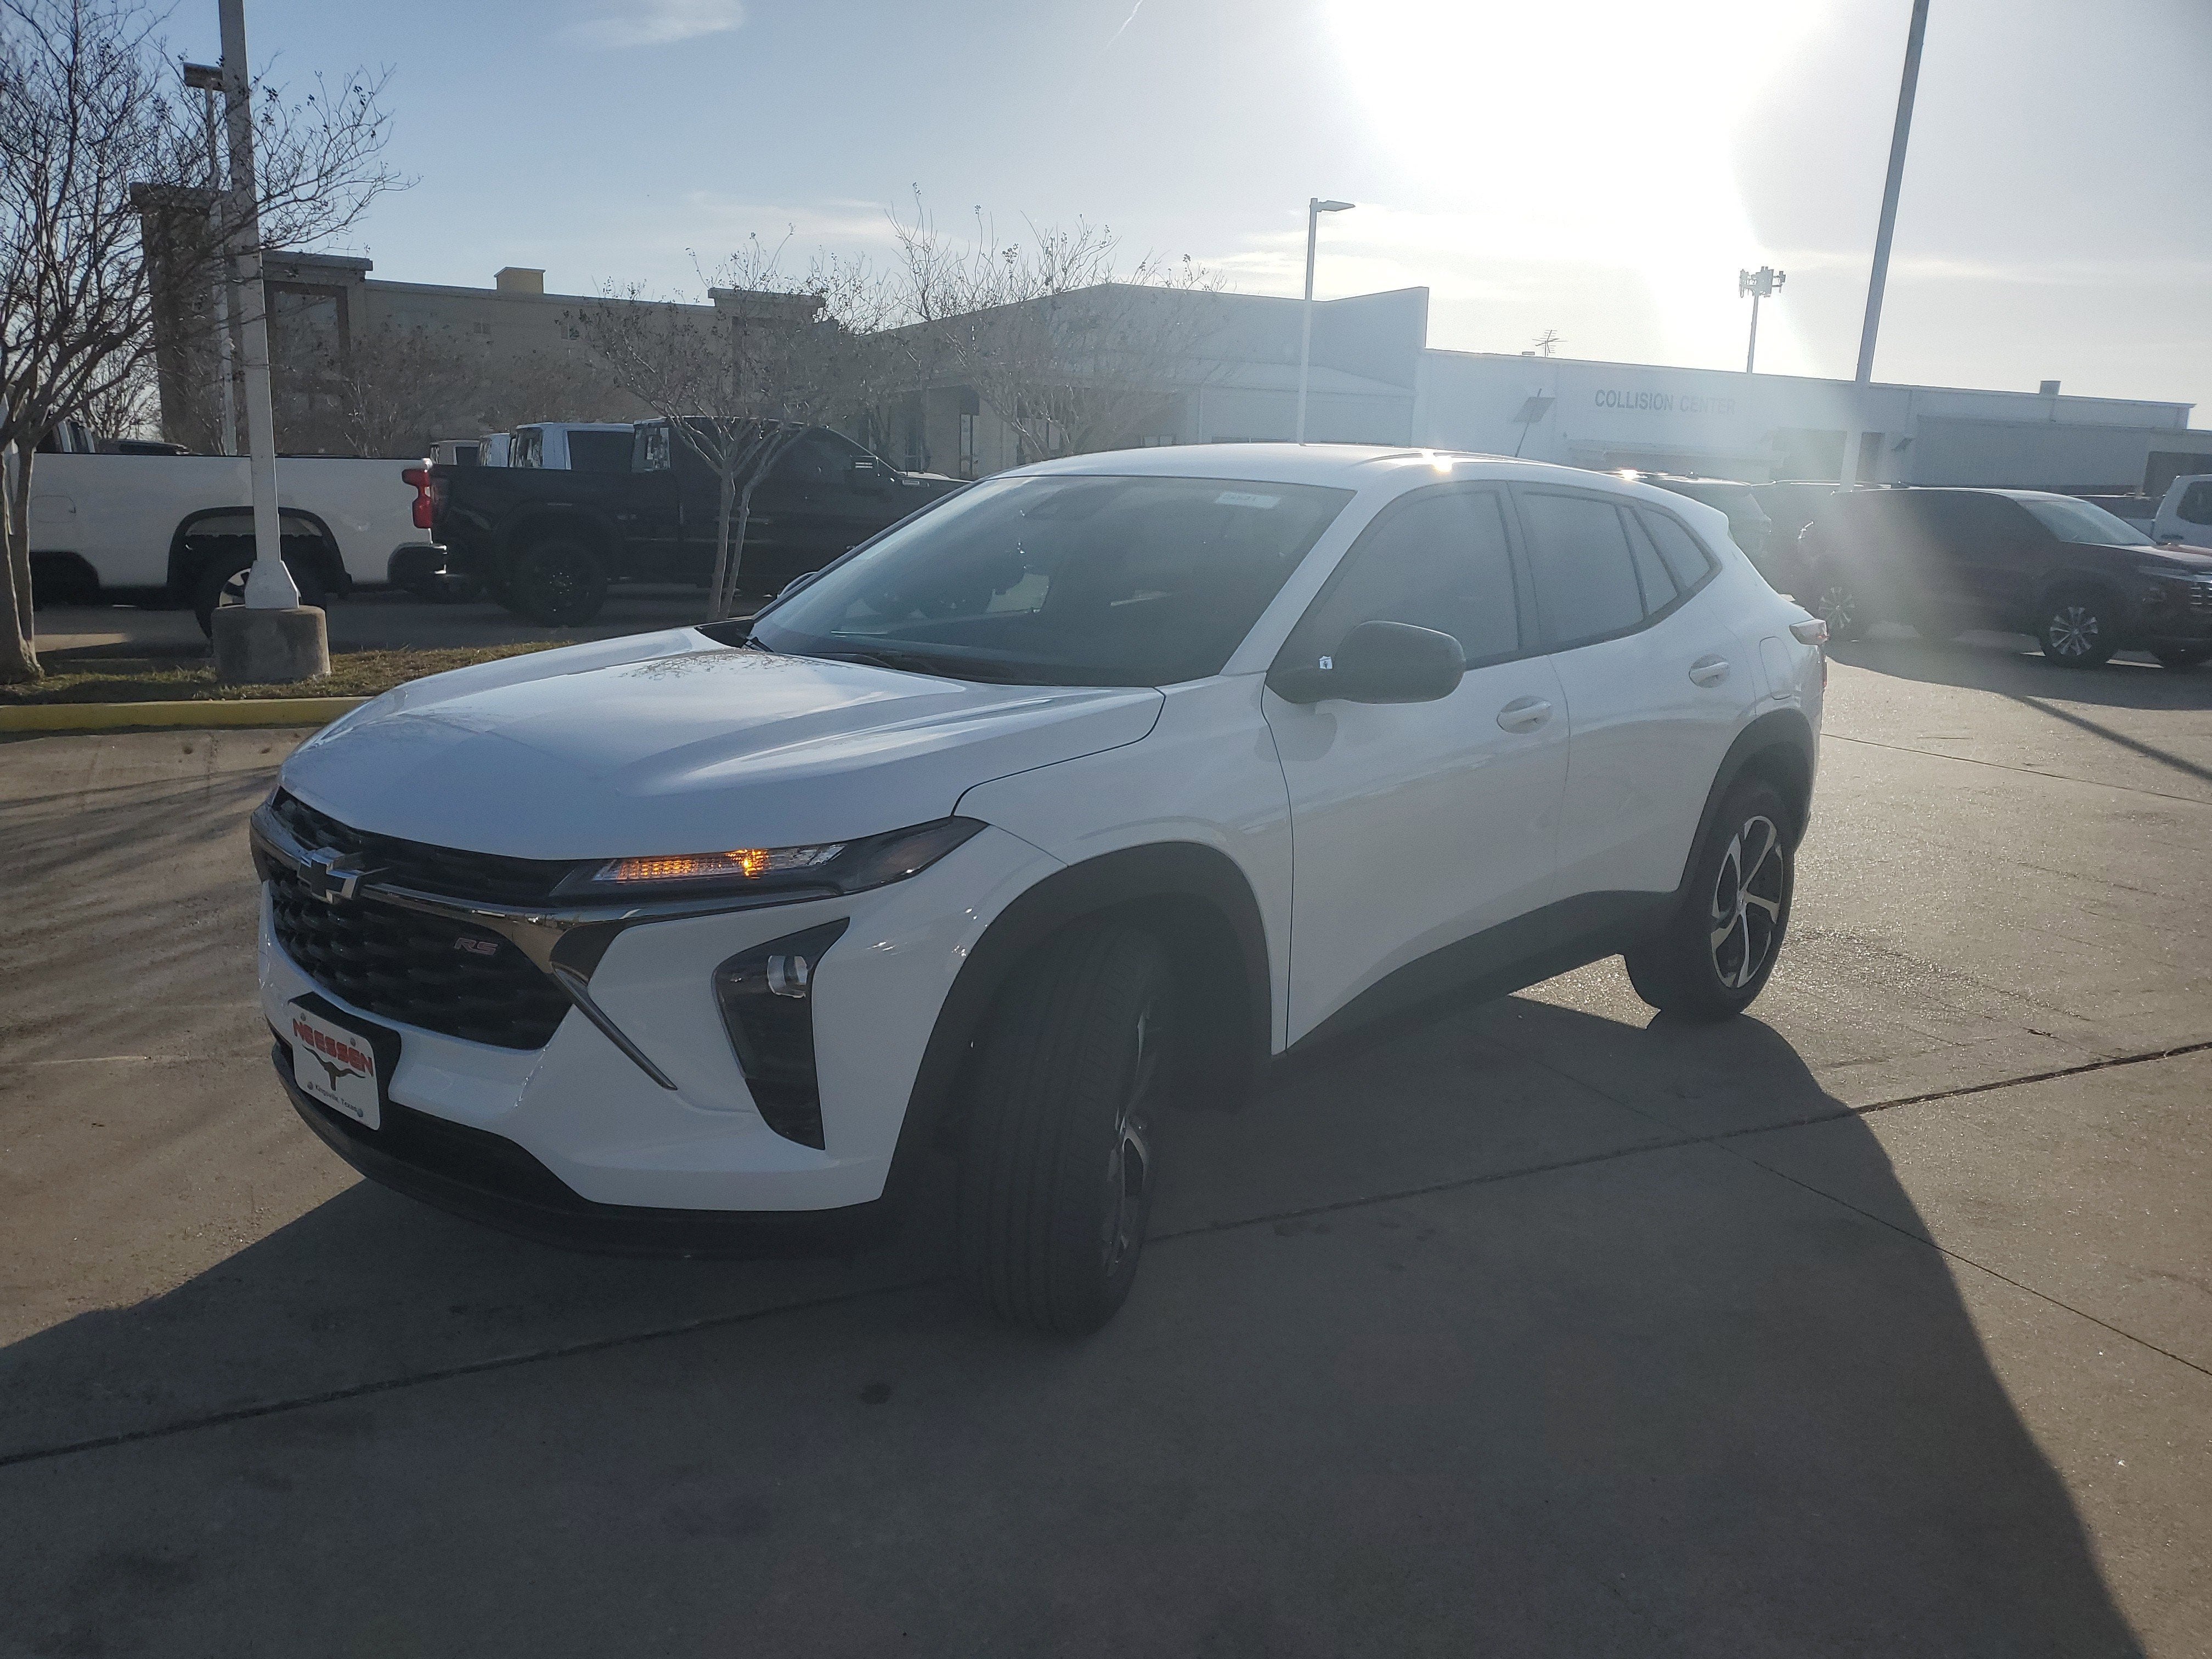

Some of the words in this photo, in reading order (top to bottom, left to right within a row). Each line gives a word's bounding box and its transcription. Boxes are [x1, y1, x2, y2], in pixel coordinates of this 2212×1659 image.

[1595, 389, 1673, 411] COLLISION
[1680, 394, 1736, 415] CENTER
[454, 938, 499, 955] RS
[292, 1018, 374, 1077] NEESSEN
[341, 1097, 358, 1112] Texas
